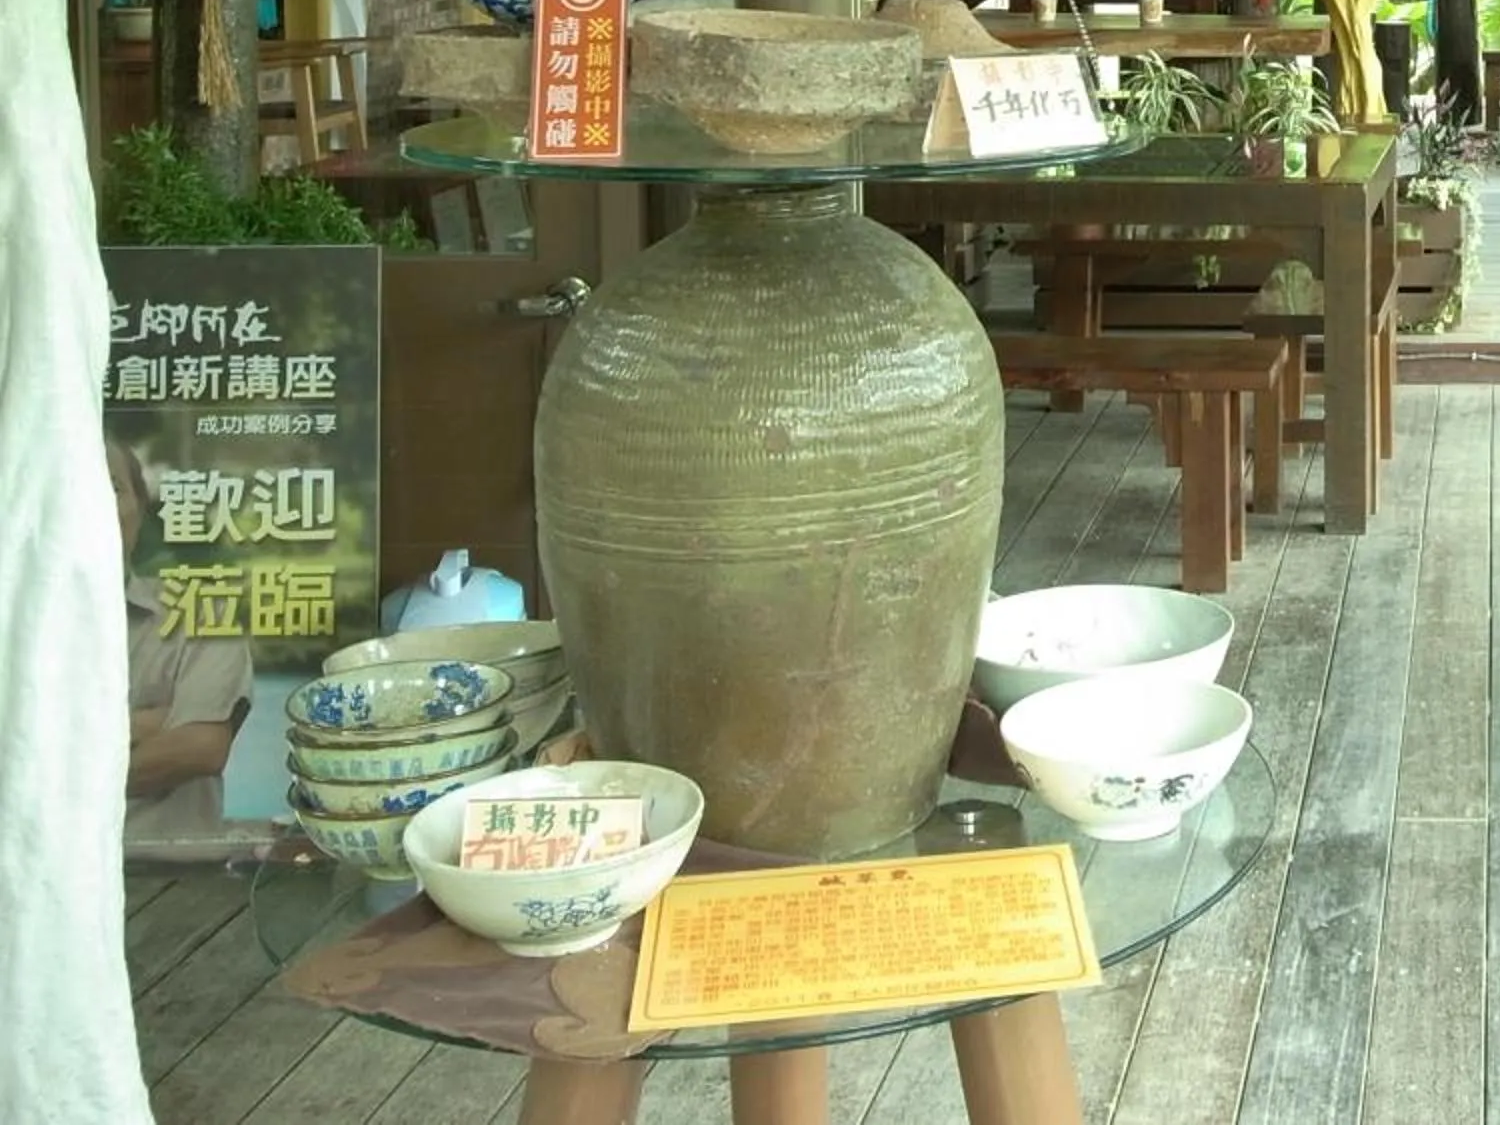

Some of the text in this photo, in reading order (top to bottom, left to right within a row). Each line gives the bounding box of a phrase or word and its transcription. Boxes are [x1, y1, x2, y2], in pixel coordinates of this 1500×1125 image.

[546, 16, 580, 147] 請勿觸碰
[102, 355, 337, 401] 創新講座
[196, 413, 338, 435] 成功案例分享
[159, 468, 337, 544] 歡迎
[158, 565, 337, 638] 蒞臨
[483, 803, 600, 836] 攝影中
